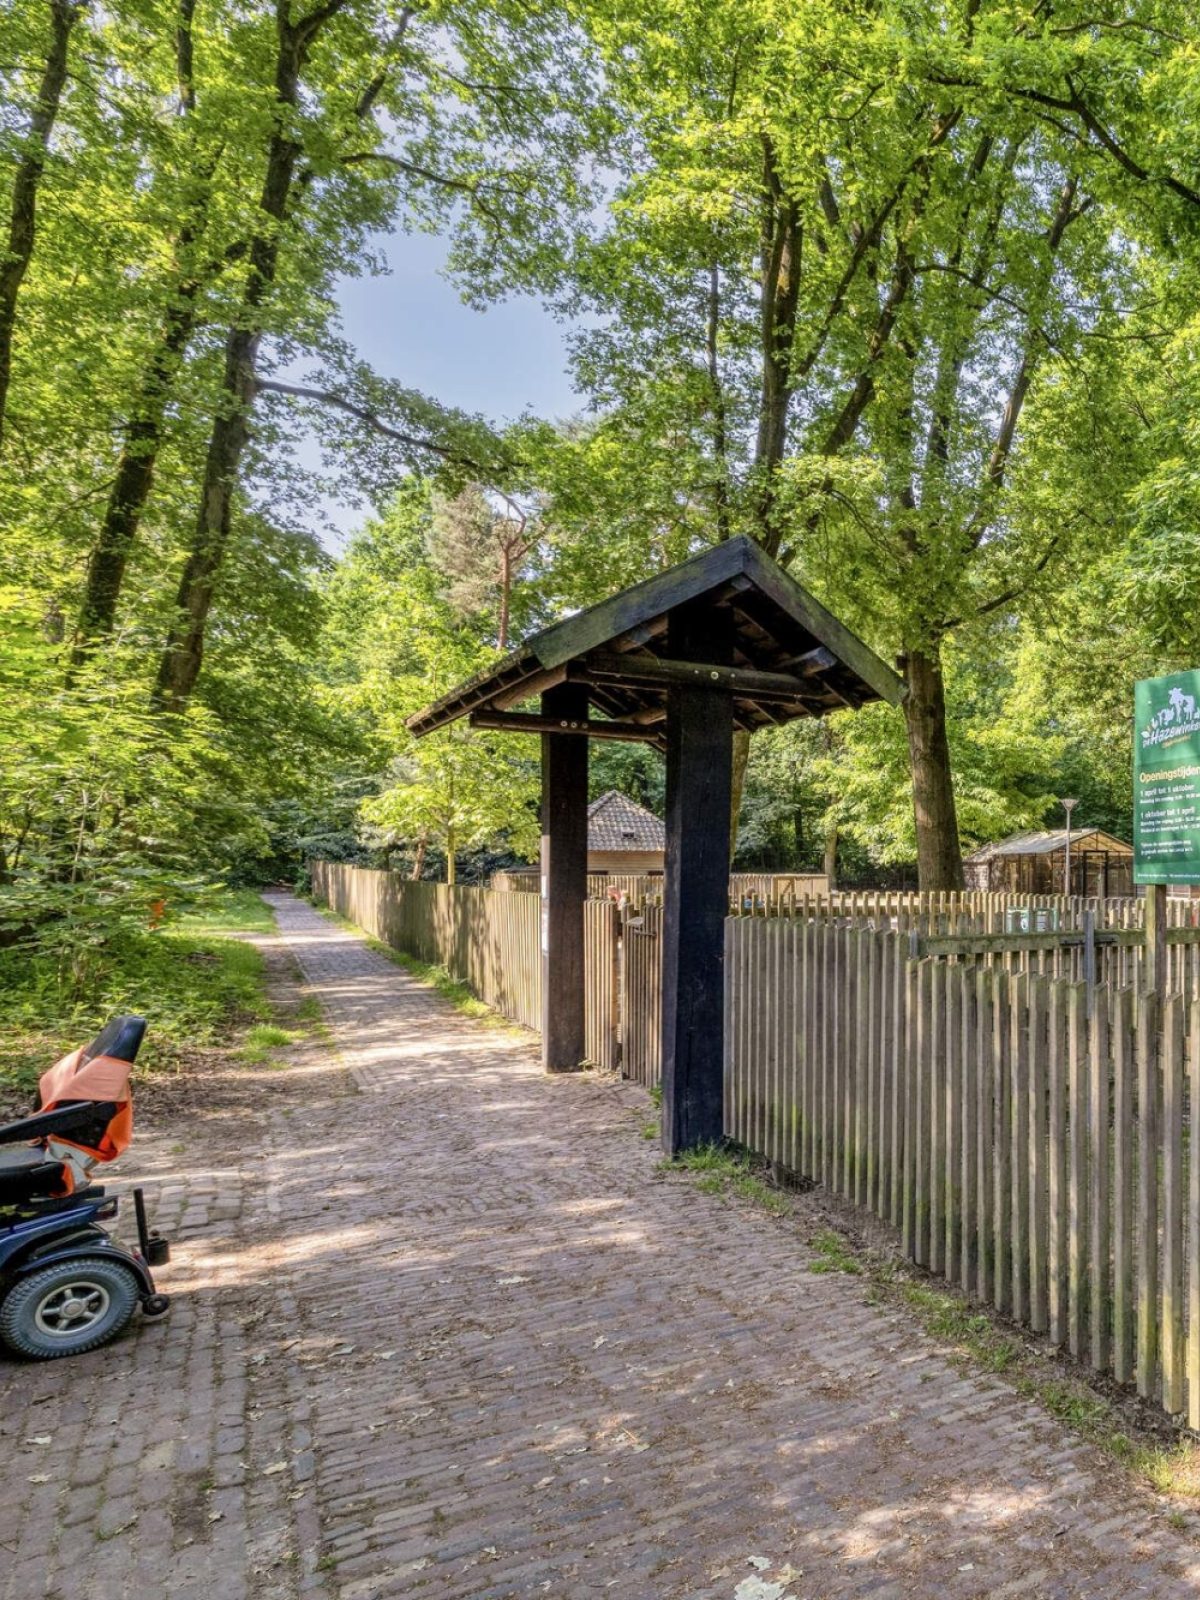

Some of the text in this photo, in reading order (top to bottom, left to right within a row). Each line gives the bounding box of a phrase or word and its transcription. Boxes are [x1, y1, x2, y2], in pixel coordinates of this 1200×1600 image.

[1144, 788, 1157, 797] april
[1172, 784, 1195, 792] oktober
[1145, 810, 1166, 818] oktober
[1182, 806, 1195, 814] april
